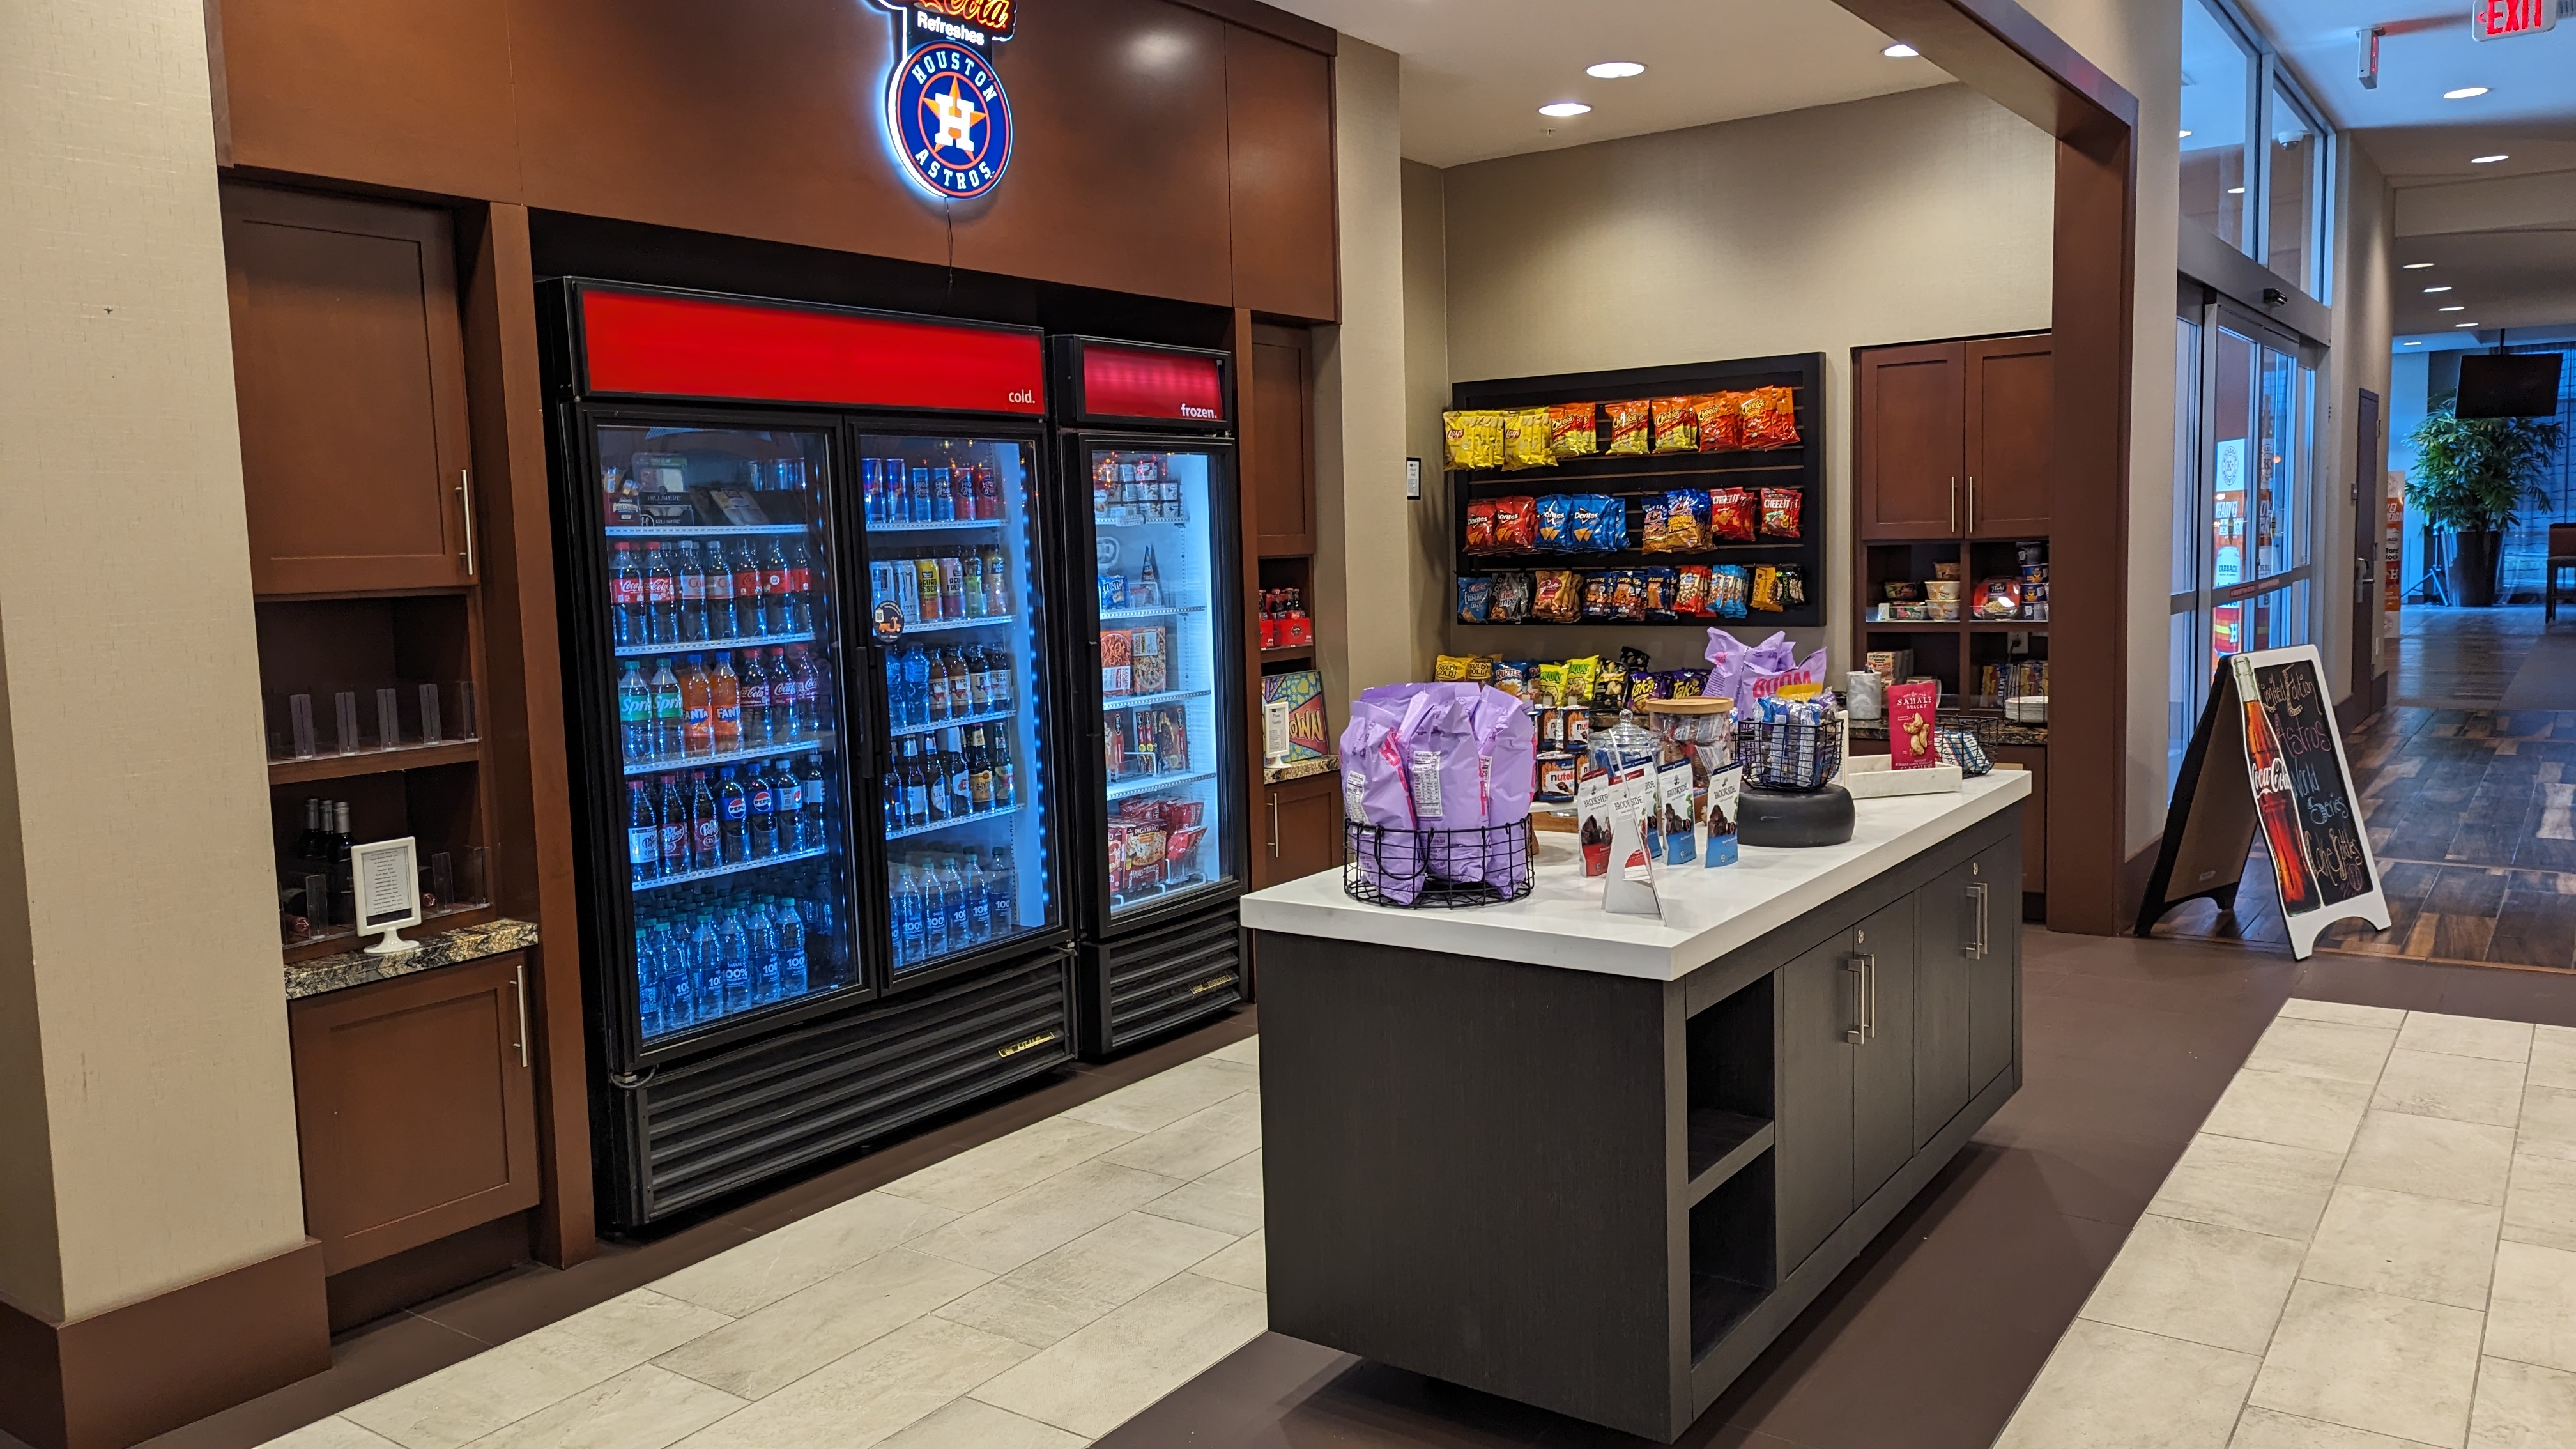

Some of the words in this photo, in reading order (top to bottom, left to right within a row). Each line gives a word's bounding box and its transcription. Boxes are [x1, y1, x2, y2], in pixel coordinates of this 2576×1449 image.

[917, 11, 985, 46] Refreshes
[2487, 0, 2543, 36] EXIT
[912, 50, 997, 102] HOUSTON
[935, 92, 974, 151] H
[915, 148, 994, 190] ASTROS
[1008, 389, 1036, 404] cold.
[1181, 403, 1217, 419] frozen.
[1753, 671, 1812, 698] BOOM
[1897, 696, 1932, 706] SAHALE
[2282, 664, 2322, 717] Edition
[2274, 713, 2332, 758] Astros
[2307, 792, 2349, 825] Series
